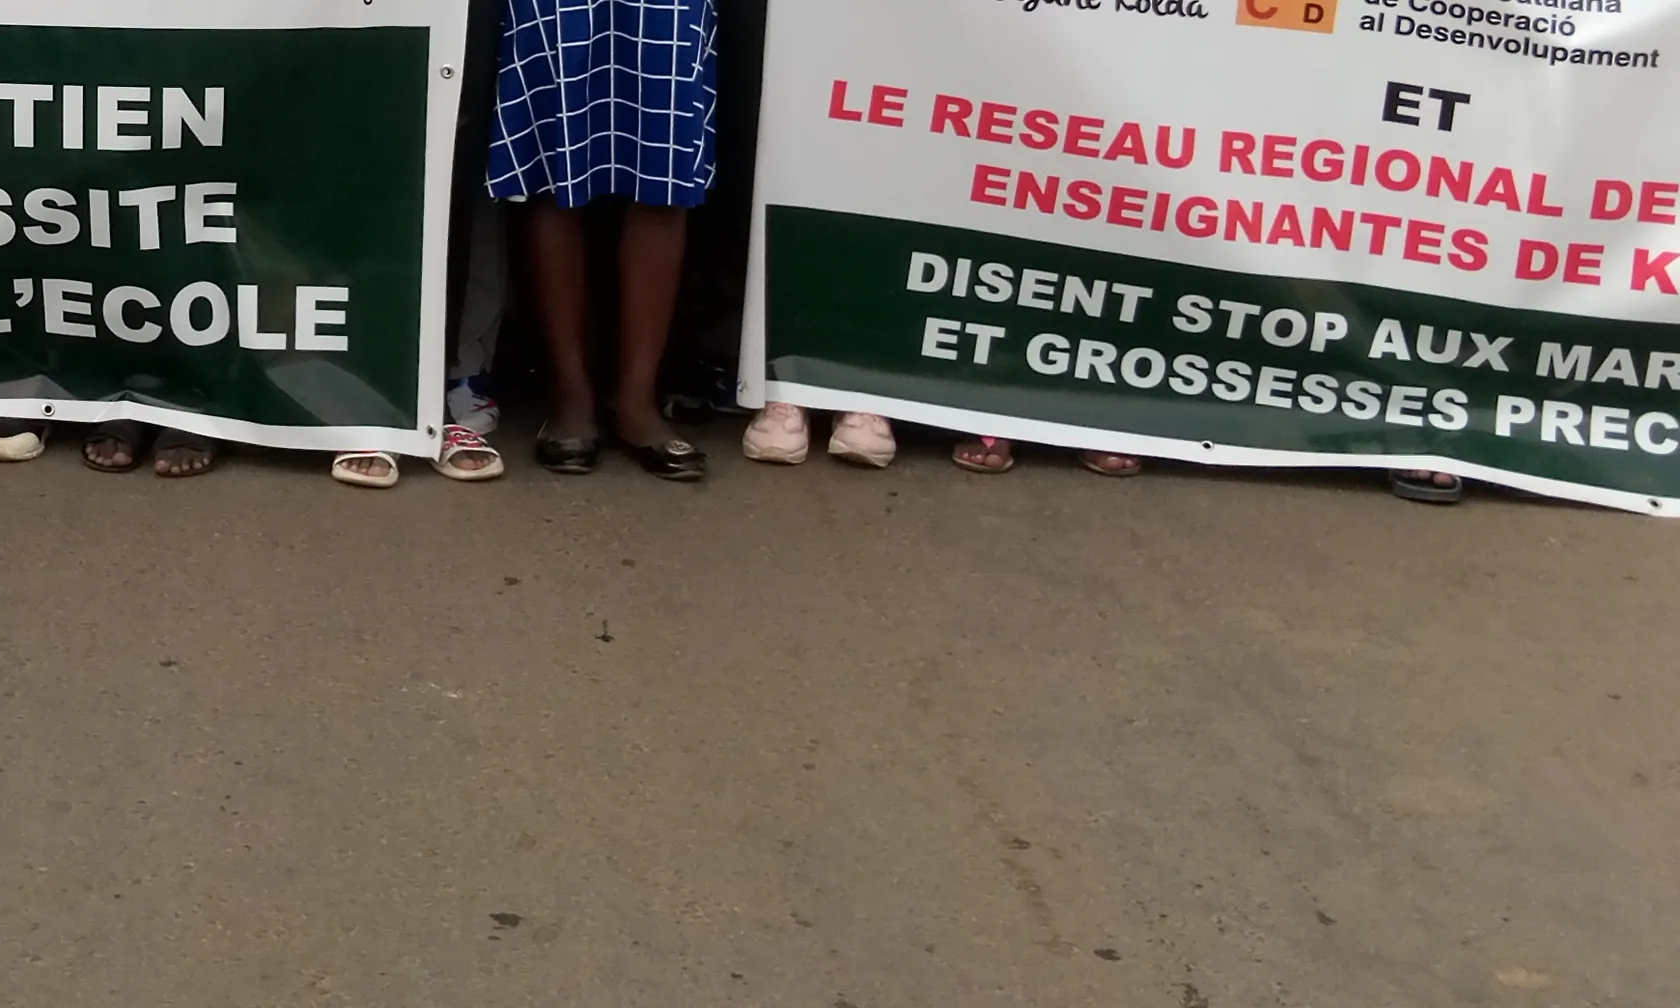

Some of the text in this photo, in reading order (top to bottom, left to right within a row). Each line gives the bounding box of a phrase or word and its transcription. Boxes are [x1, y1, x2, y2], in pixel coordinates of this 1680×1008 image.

[1360, 13, 1659, 68] al Desenvolupament
[829, 80, 1679, 224] LE RESEAU REGIONAL DE
[1382, 81, 1471, 132] ET
[970, 164, 1604, 285] ENSEIGNANTES DE
[907, 252, 1153, 322] DISENT
[1173, 295, 1348, 352] STOP
[1368, 319, 1513, 372] AUX
[922, 318, 1005, 364] ET
[1027, 334, 1468, 430] GROSSESSES
